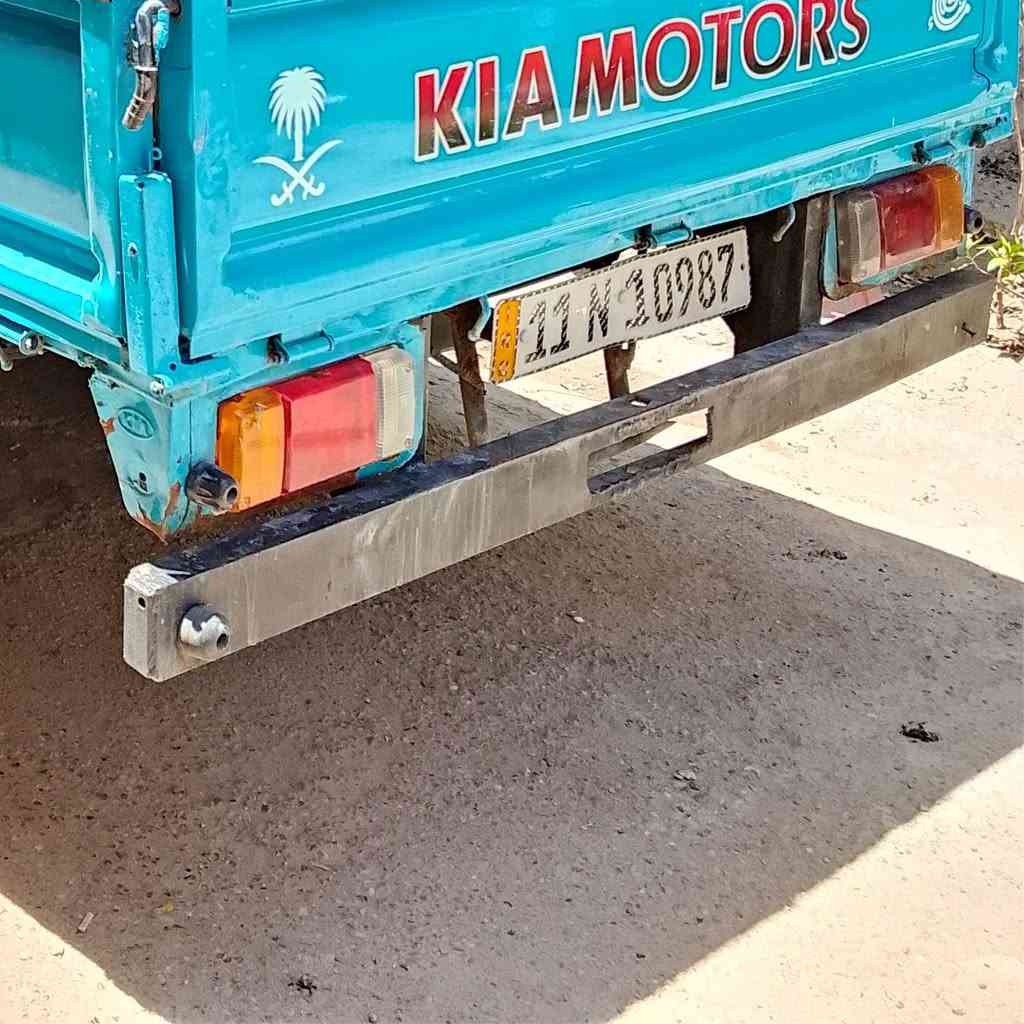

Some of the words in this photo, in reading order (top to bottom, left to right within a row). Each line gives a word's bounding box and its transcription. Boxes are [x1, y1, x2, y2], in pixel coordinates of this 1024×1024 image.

[413, 45, 563, 163] KIA
[525, 291, 571, 364] 11
[625, 242, 735, 329] 10987
